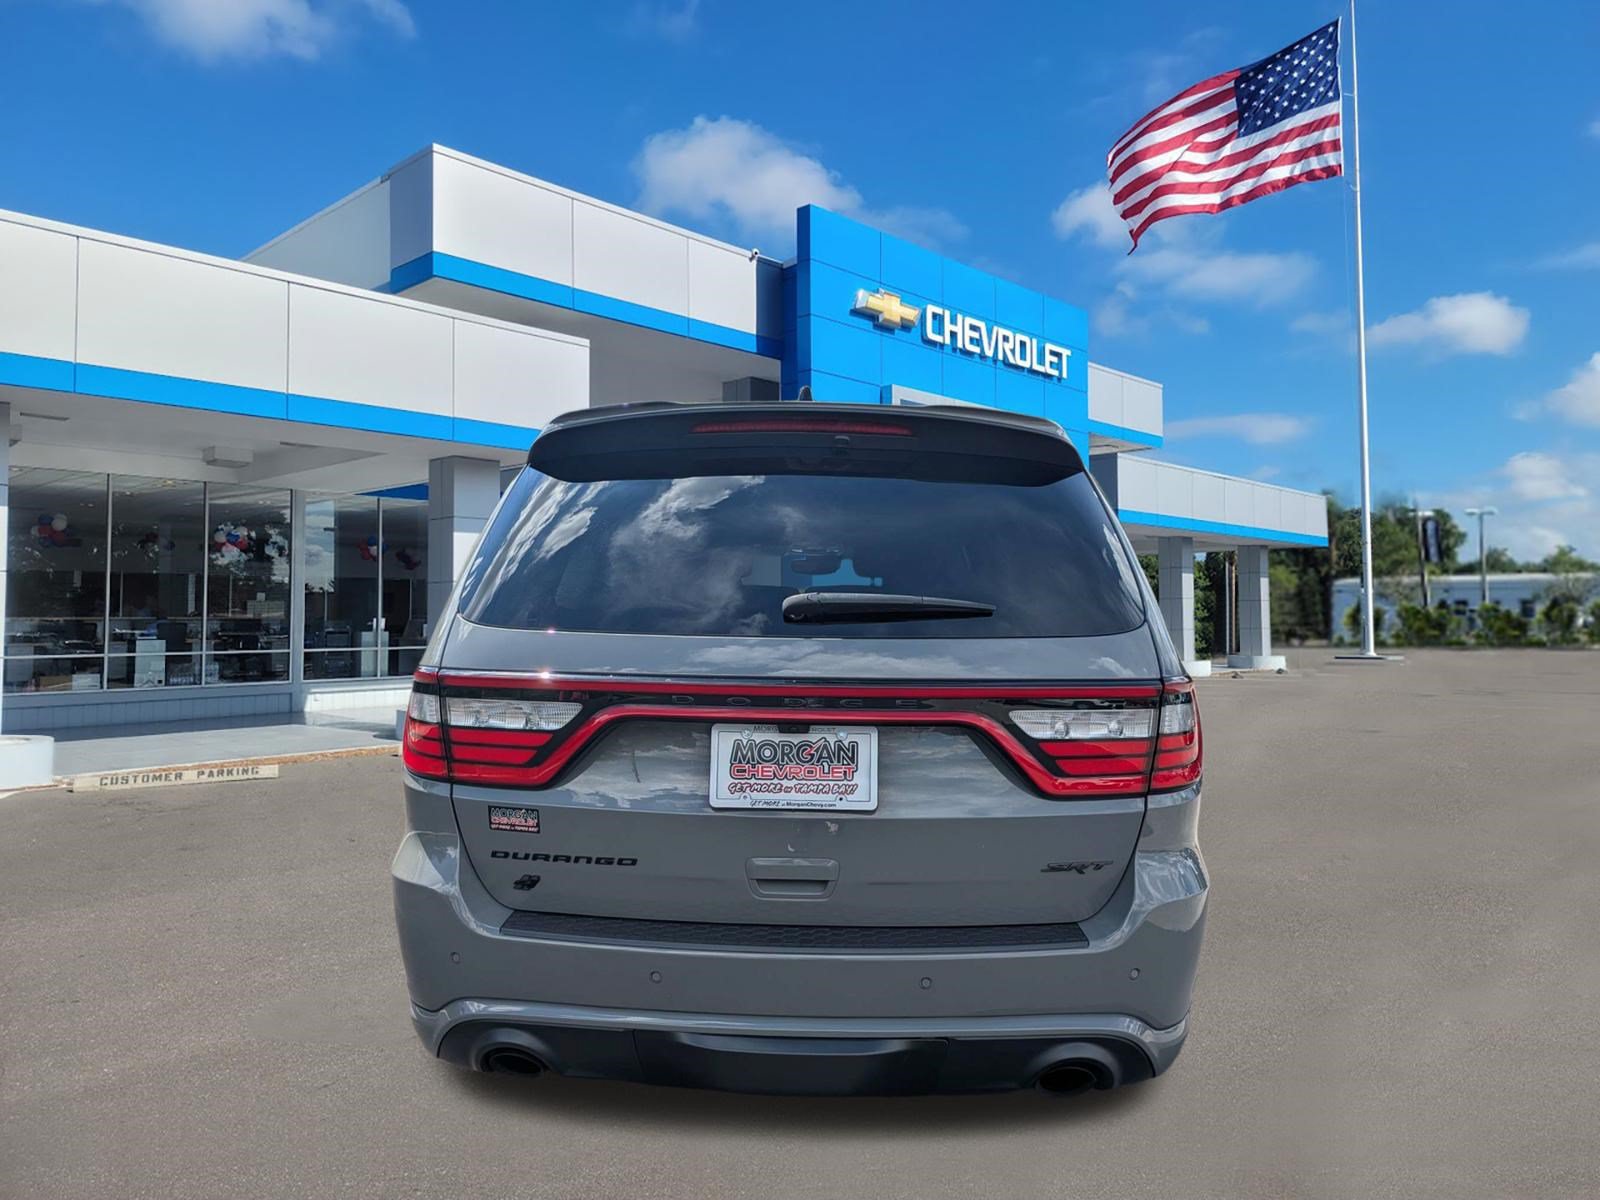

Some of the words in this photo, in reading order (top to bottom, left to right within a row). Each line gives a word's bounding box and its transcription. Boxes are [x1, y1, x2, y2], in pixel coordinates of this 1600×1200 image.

[925, 303, 1072, 379] CHEVROLET
[671, 695, 920, 708] DODGE
[730, 738, 858, 766] MORGAN
[100, 772, 183, 786] CUSTOMER
[197, 766, 259, 779] PARKING
[730, 764, 858, 781] CHEVROLET
[728, 782, 750, 794] GET
[750, 783, 782, 793] MORE
[794, 783, 830, 794] TAMPA
[831, 783, 858, 795] BAY!
[490, 807, 538, 820] MORGAN
[491, 850, 638, 867] DURANGO
